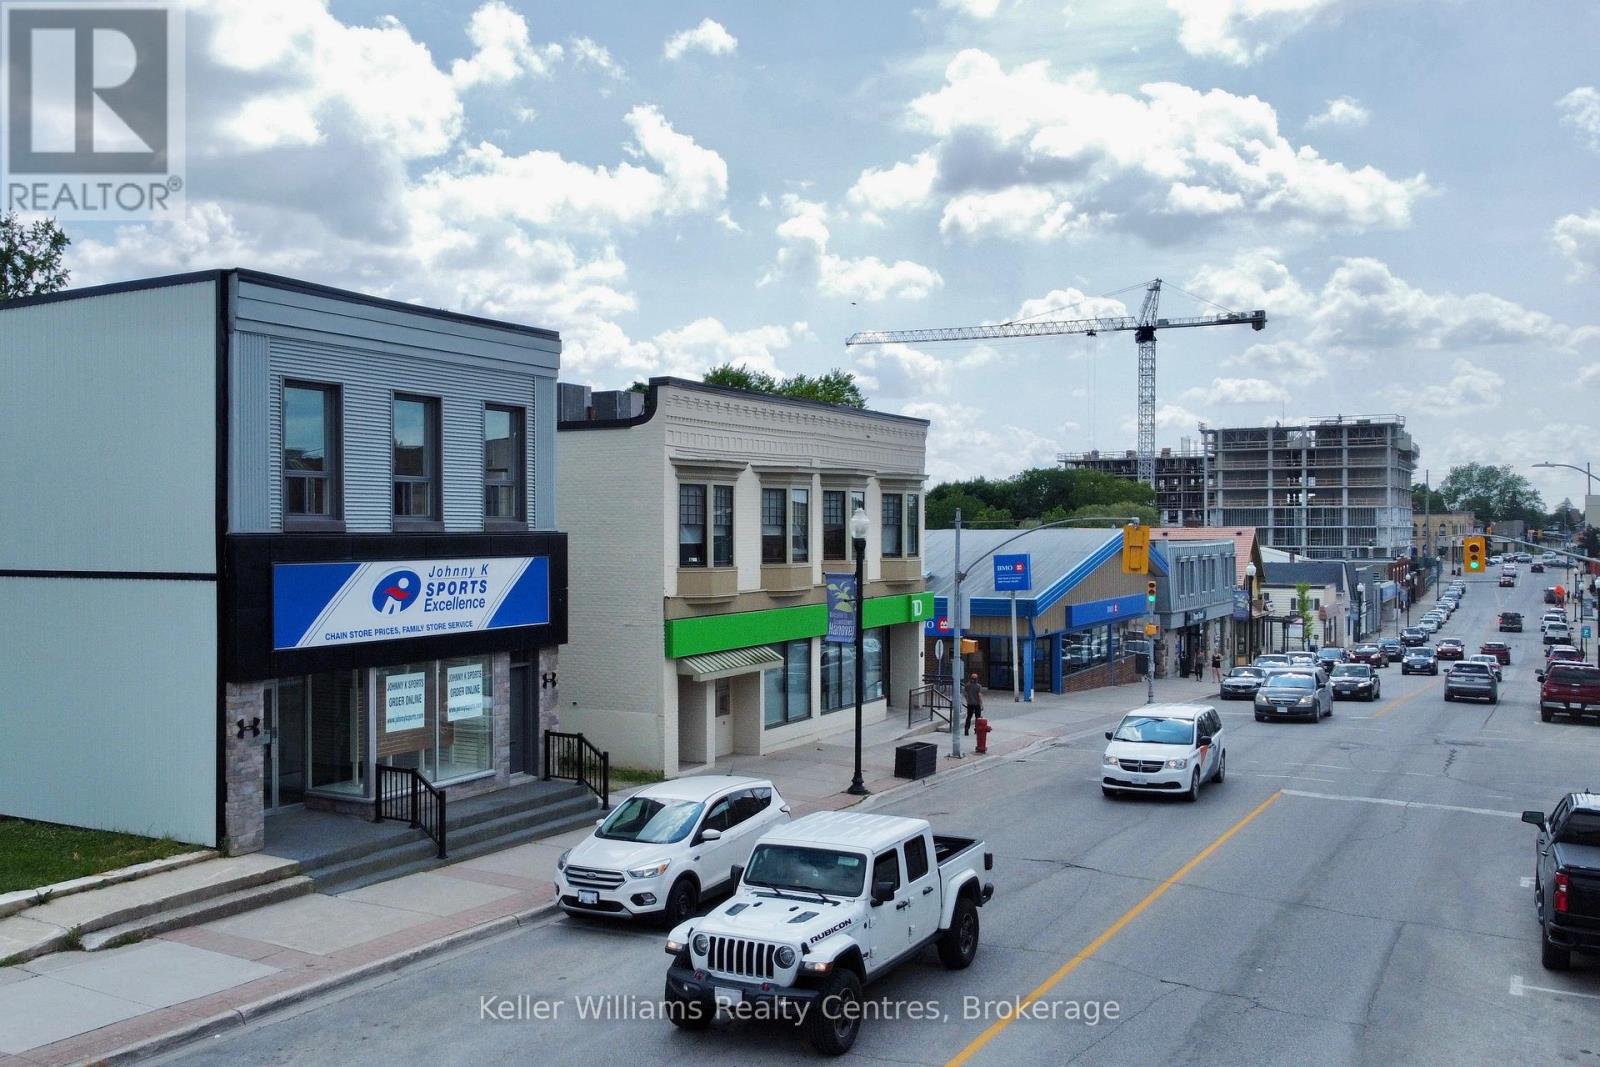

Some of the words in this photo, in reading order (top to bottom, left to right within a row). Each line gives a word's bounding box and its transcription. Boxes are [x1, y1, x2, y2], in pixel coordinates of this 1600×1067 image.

[428, 565, 475, 578] Johnny
[481, 564, 488, 575] K
[426, 579, 488, 596] SPORTS
[424, 597, 486, 612] Excellence
[325, 630, 348, 641] CHAIN
[349, 628, 373, 639] STORE
[374, 626, 401, 638] PRICES,
[402, 624, 425, 635] FAMILY
[426, 622, 447, 632] STORE
[448, 620, 473, 630] SERVICE
[467, 669, 482, 679] SPORTS
[387, 681, 404, 691] JOHNNY
[408, 678, 424, 689] SPORTS
[450, 686, 465, 697] ORDER
[465, 684, 481, 695] ONLINE
[389, 696, 405, 708] ORDER
[405, 693, 422, 705] ONLINE
[810, 918, 852, 944] RUBICON
